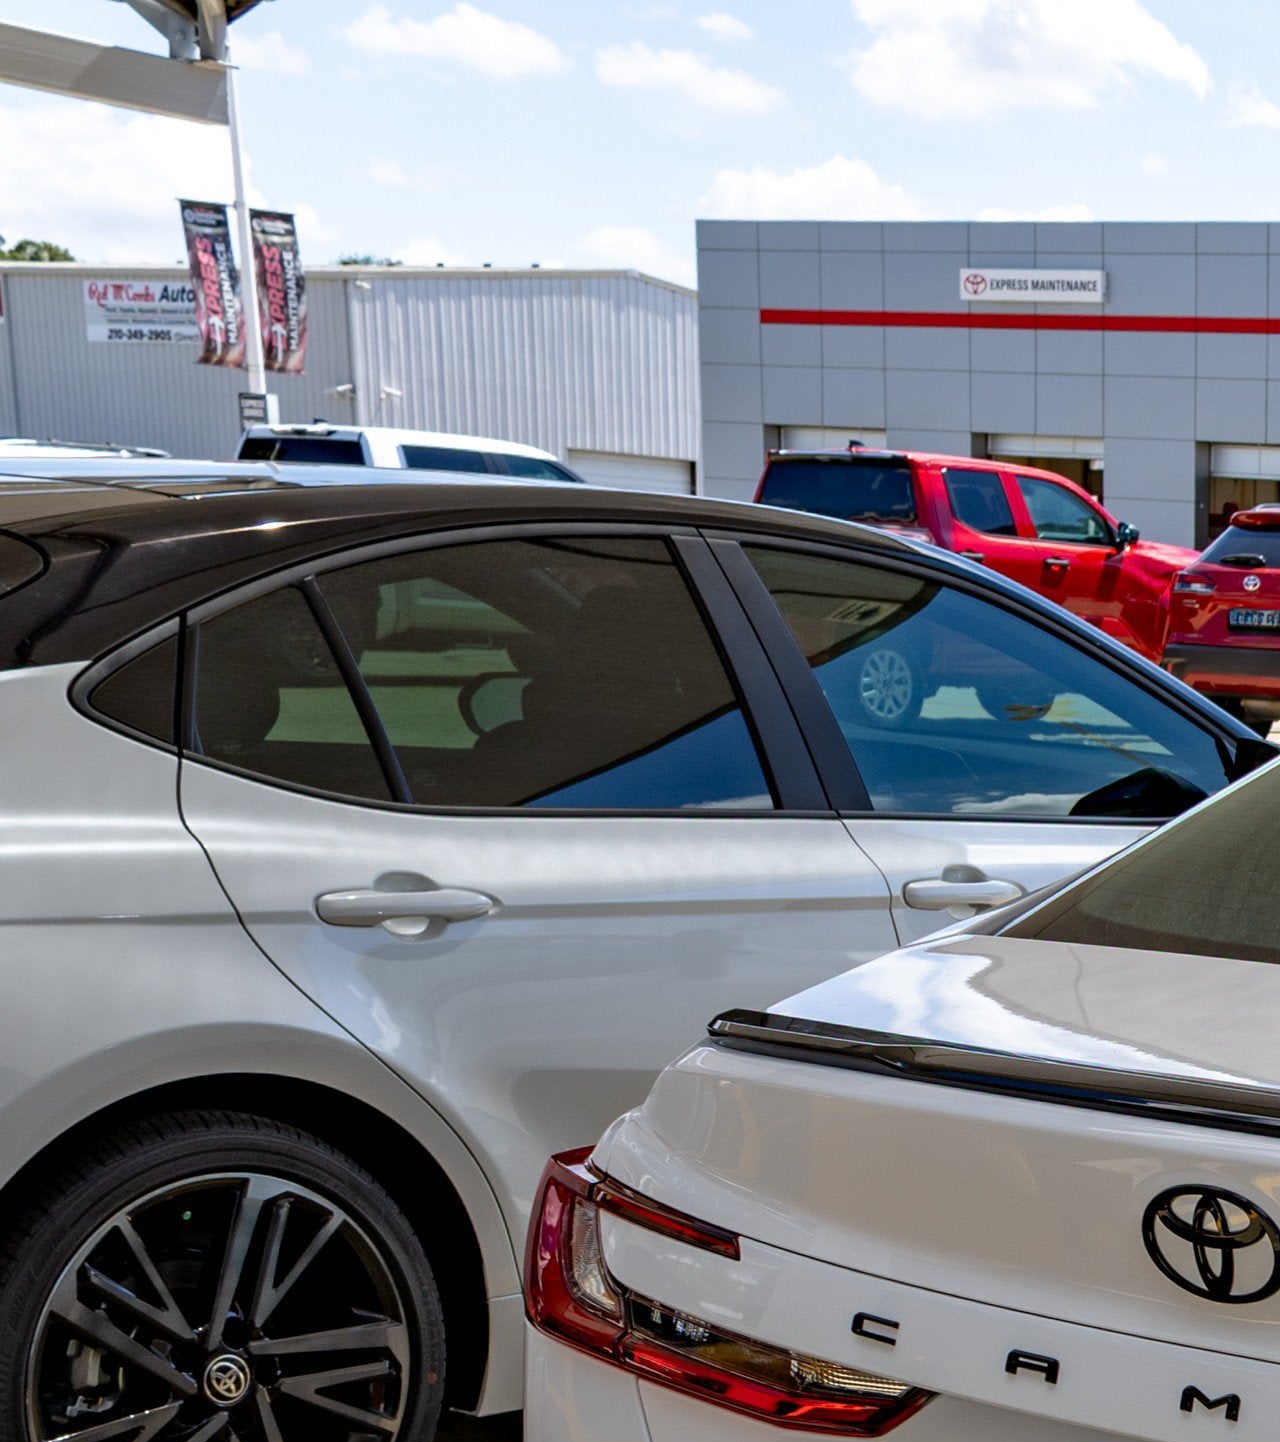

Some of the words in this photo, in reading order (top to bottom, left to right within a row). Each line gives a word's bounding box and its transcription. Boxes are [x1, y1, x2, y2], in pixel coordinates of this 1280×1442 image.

[214, 242, 239, 344] MAINTENANCE
[262, 243, 289, 350] EXPRESS
[282, 250, 299, 350] MAINTENANCE
[990, 279, 1028, 290] EXPRESS
[1031, 280, 1098, 292] MAINTENANCE
